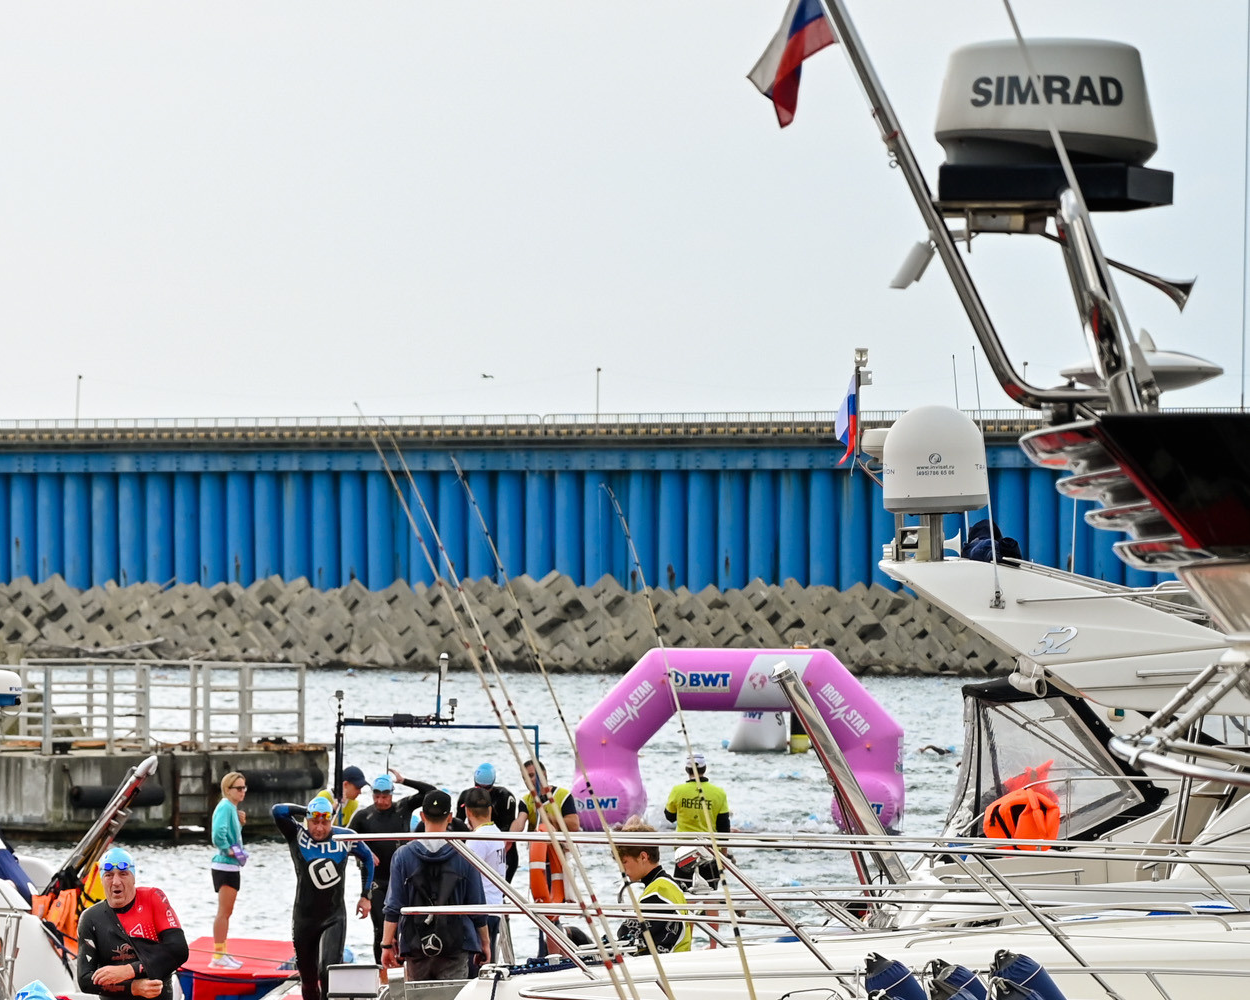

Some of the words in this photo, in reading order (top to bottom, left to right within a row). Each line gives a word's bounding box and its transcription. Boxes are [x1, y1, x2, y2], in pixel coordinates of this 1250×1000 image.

[971, 74, 1124, 107] SIMRAD
[1028, 626, 1078, 656] 52
[689, 673, 730, 687] BWT
[603, 706, 627, 731] IRON
[628, 680, 654, 705] STAR
[820, 683, 845, 707] IRON
[845, 709, 871, 736] STAR
[587, 797, 618, 809] BWT
[166, 909, 178, 928] RED
